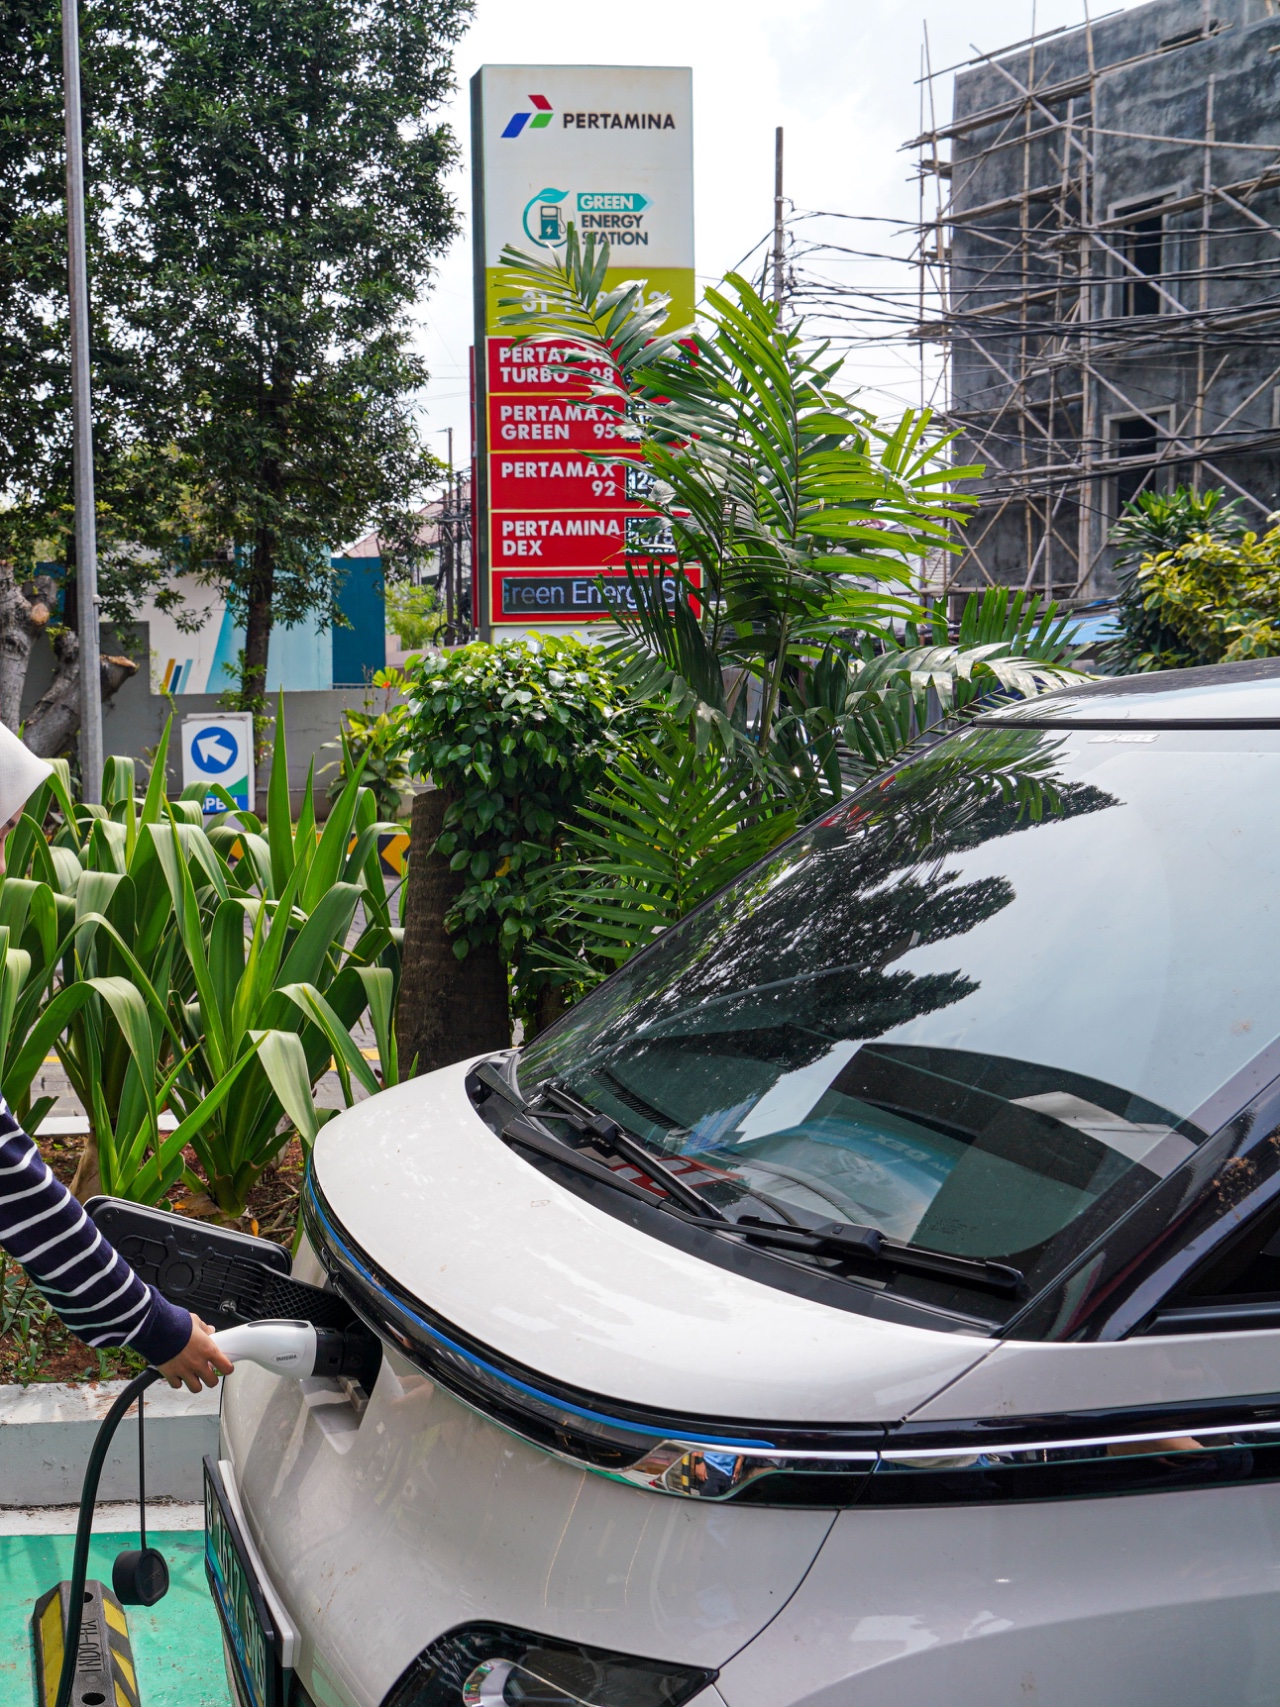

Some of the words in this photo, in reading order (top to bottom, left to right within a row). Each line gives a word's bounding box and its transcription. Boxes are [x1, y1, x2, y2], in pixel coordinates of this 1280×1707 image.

[563, 113, 676, 129] PERTAMINA
[580, 195, 634, 209] GREEN
[581, 214, 644, 228] ENERGY
[499, 346, 611, 363] PERTA
[500, 366, 569, 383] TURBO
[590, 367, 614, 383] 98
[500, 405, 615, 421] PERTAMAX
[501, 423, 570, 440] GREEN
[593, 423, 616, 439] 95
[501, 461, 615, 478] PERTAMAX
[591, 480, 616, 497] 92
[502, 519, 620, 536] PERTAMINA
[502, 540, 543, 556] DEX
[201, 796, 239, 811] PB
